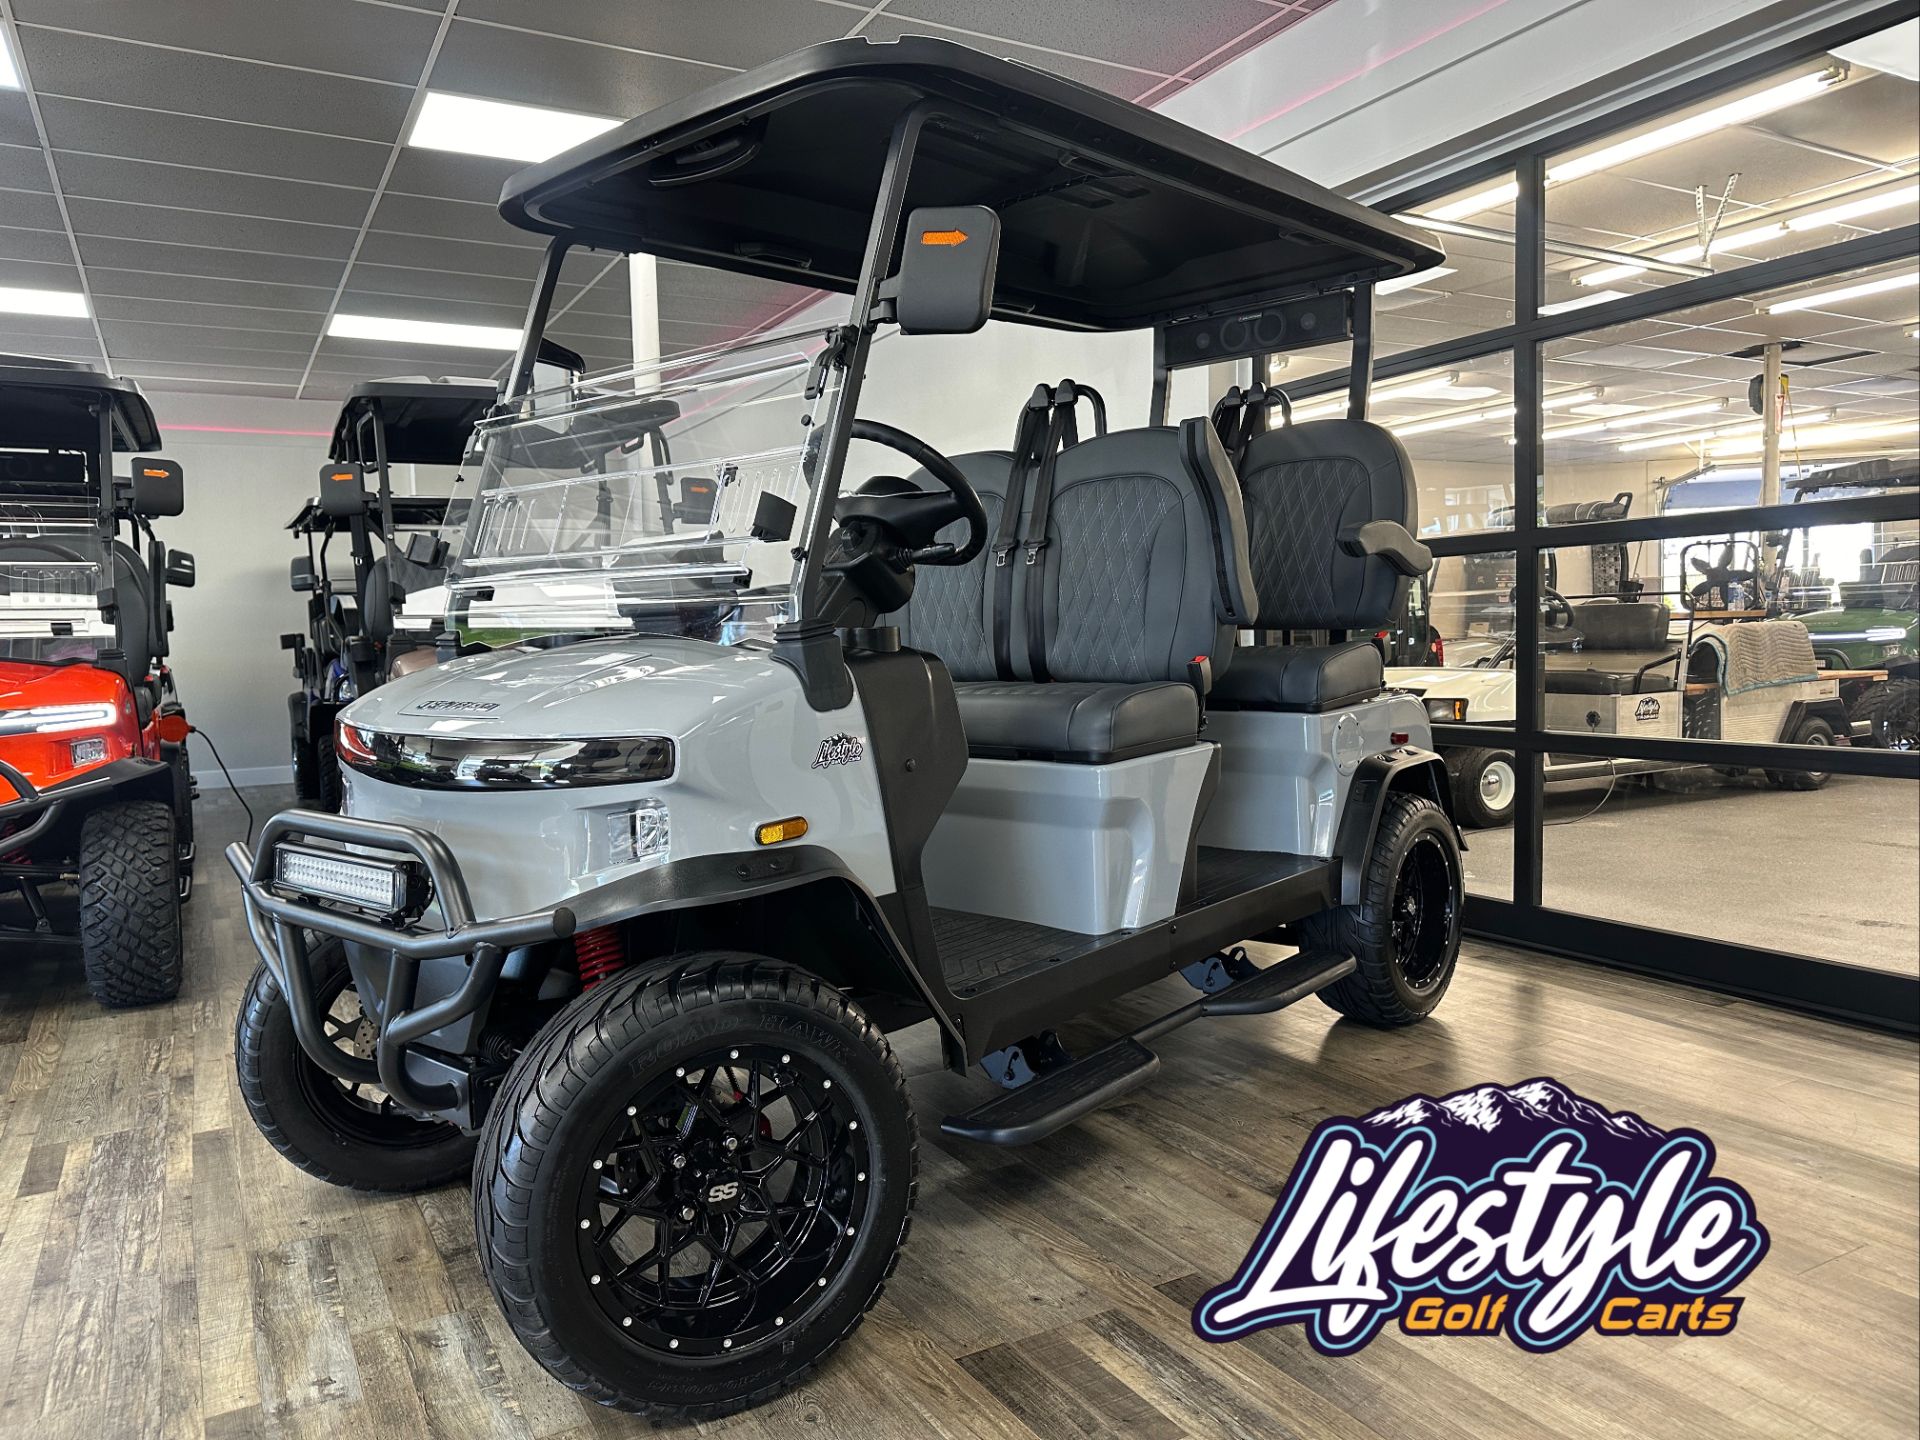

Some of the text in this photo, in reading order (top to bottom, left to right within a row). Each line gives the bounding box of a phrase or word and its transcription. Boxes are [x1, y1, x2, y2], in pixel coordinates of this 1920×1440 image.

[812, 738, 863, 769] Lifestyle
[629, 1014, 857, 1078] ROAD HAWK
[708, 1181, 739, 1203] SS
